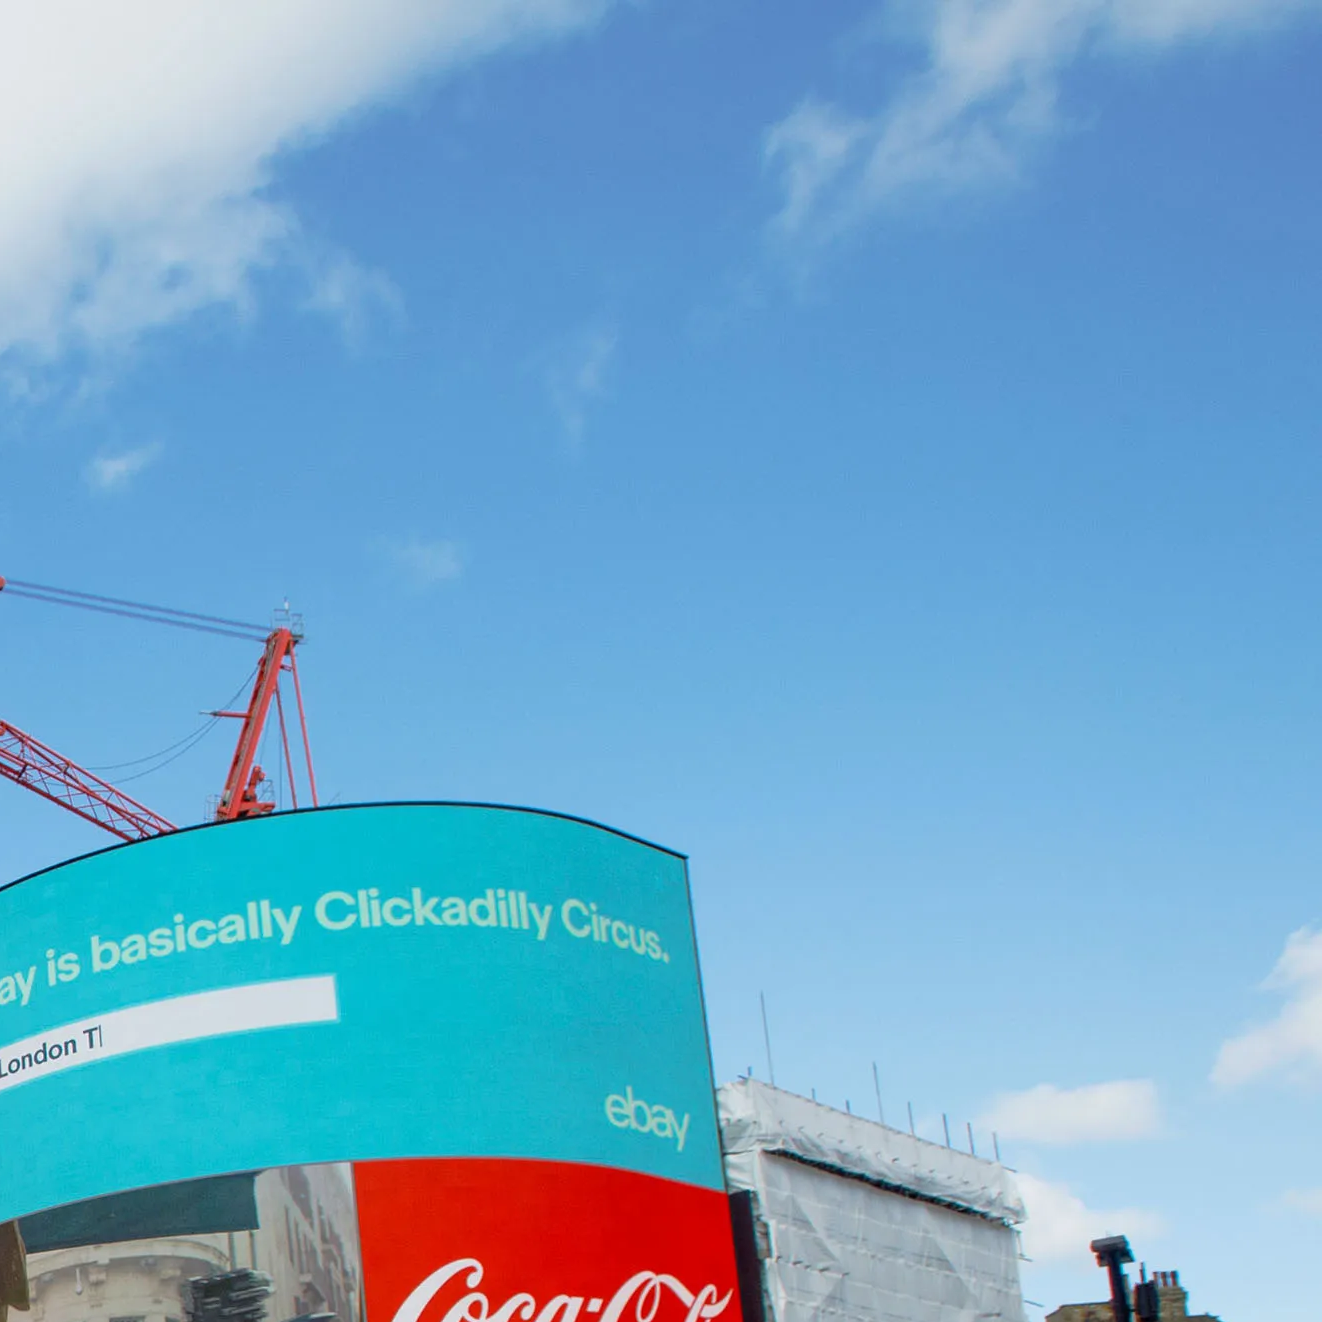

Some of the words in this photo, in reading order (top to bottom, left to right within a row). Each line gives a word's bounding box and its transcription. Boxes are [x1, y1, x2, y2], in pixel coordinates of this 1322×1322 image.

[47, 949, 80, 986] is
[91, 899, 302, 973] basically
[314, 887, 553, 941] Clickadilly
[561, 898, 670, 963] Circus.
[604, 1086, 690, 1153] ebay
